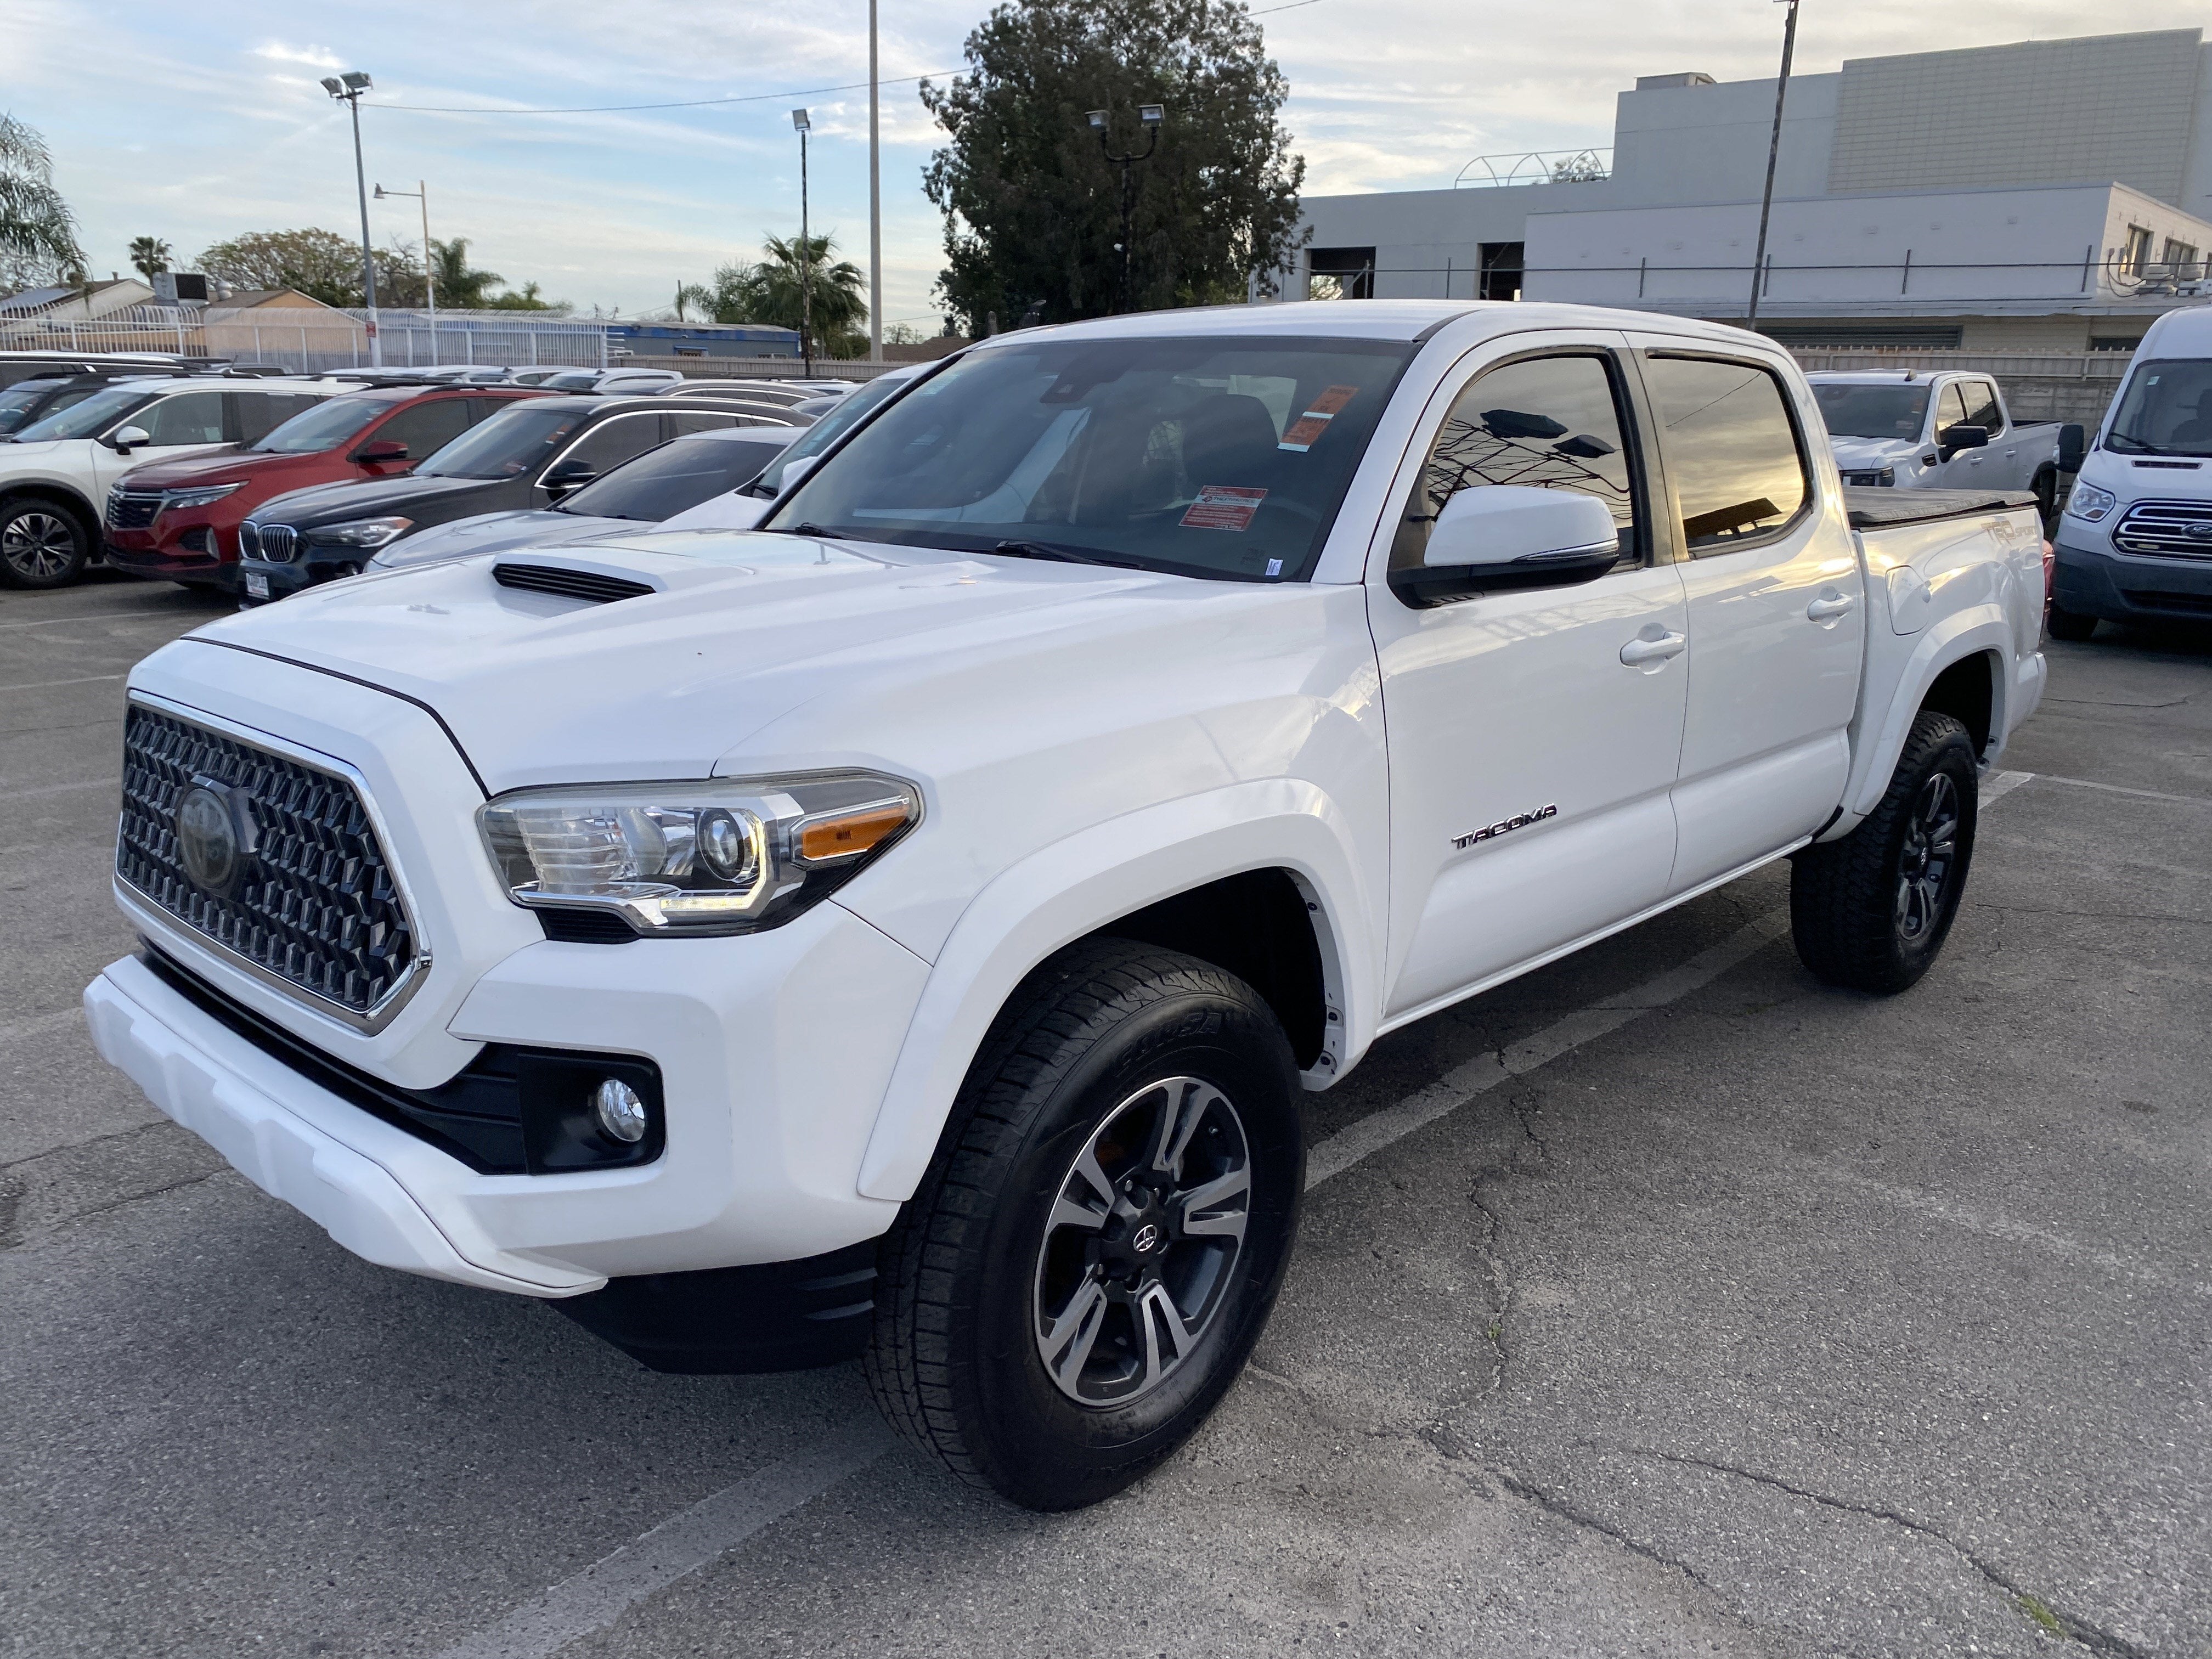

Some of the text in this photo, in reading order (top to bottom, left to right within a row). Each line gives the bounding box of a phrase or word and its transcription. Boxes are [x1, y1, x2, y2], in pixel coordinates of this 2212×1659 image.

[1980, 521, 2037, 545] TRD SPORT
[1451, 803, 1557, 850] TACOMA
